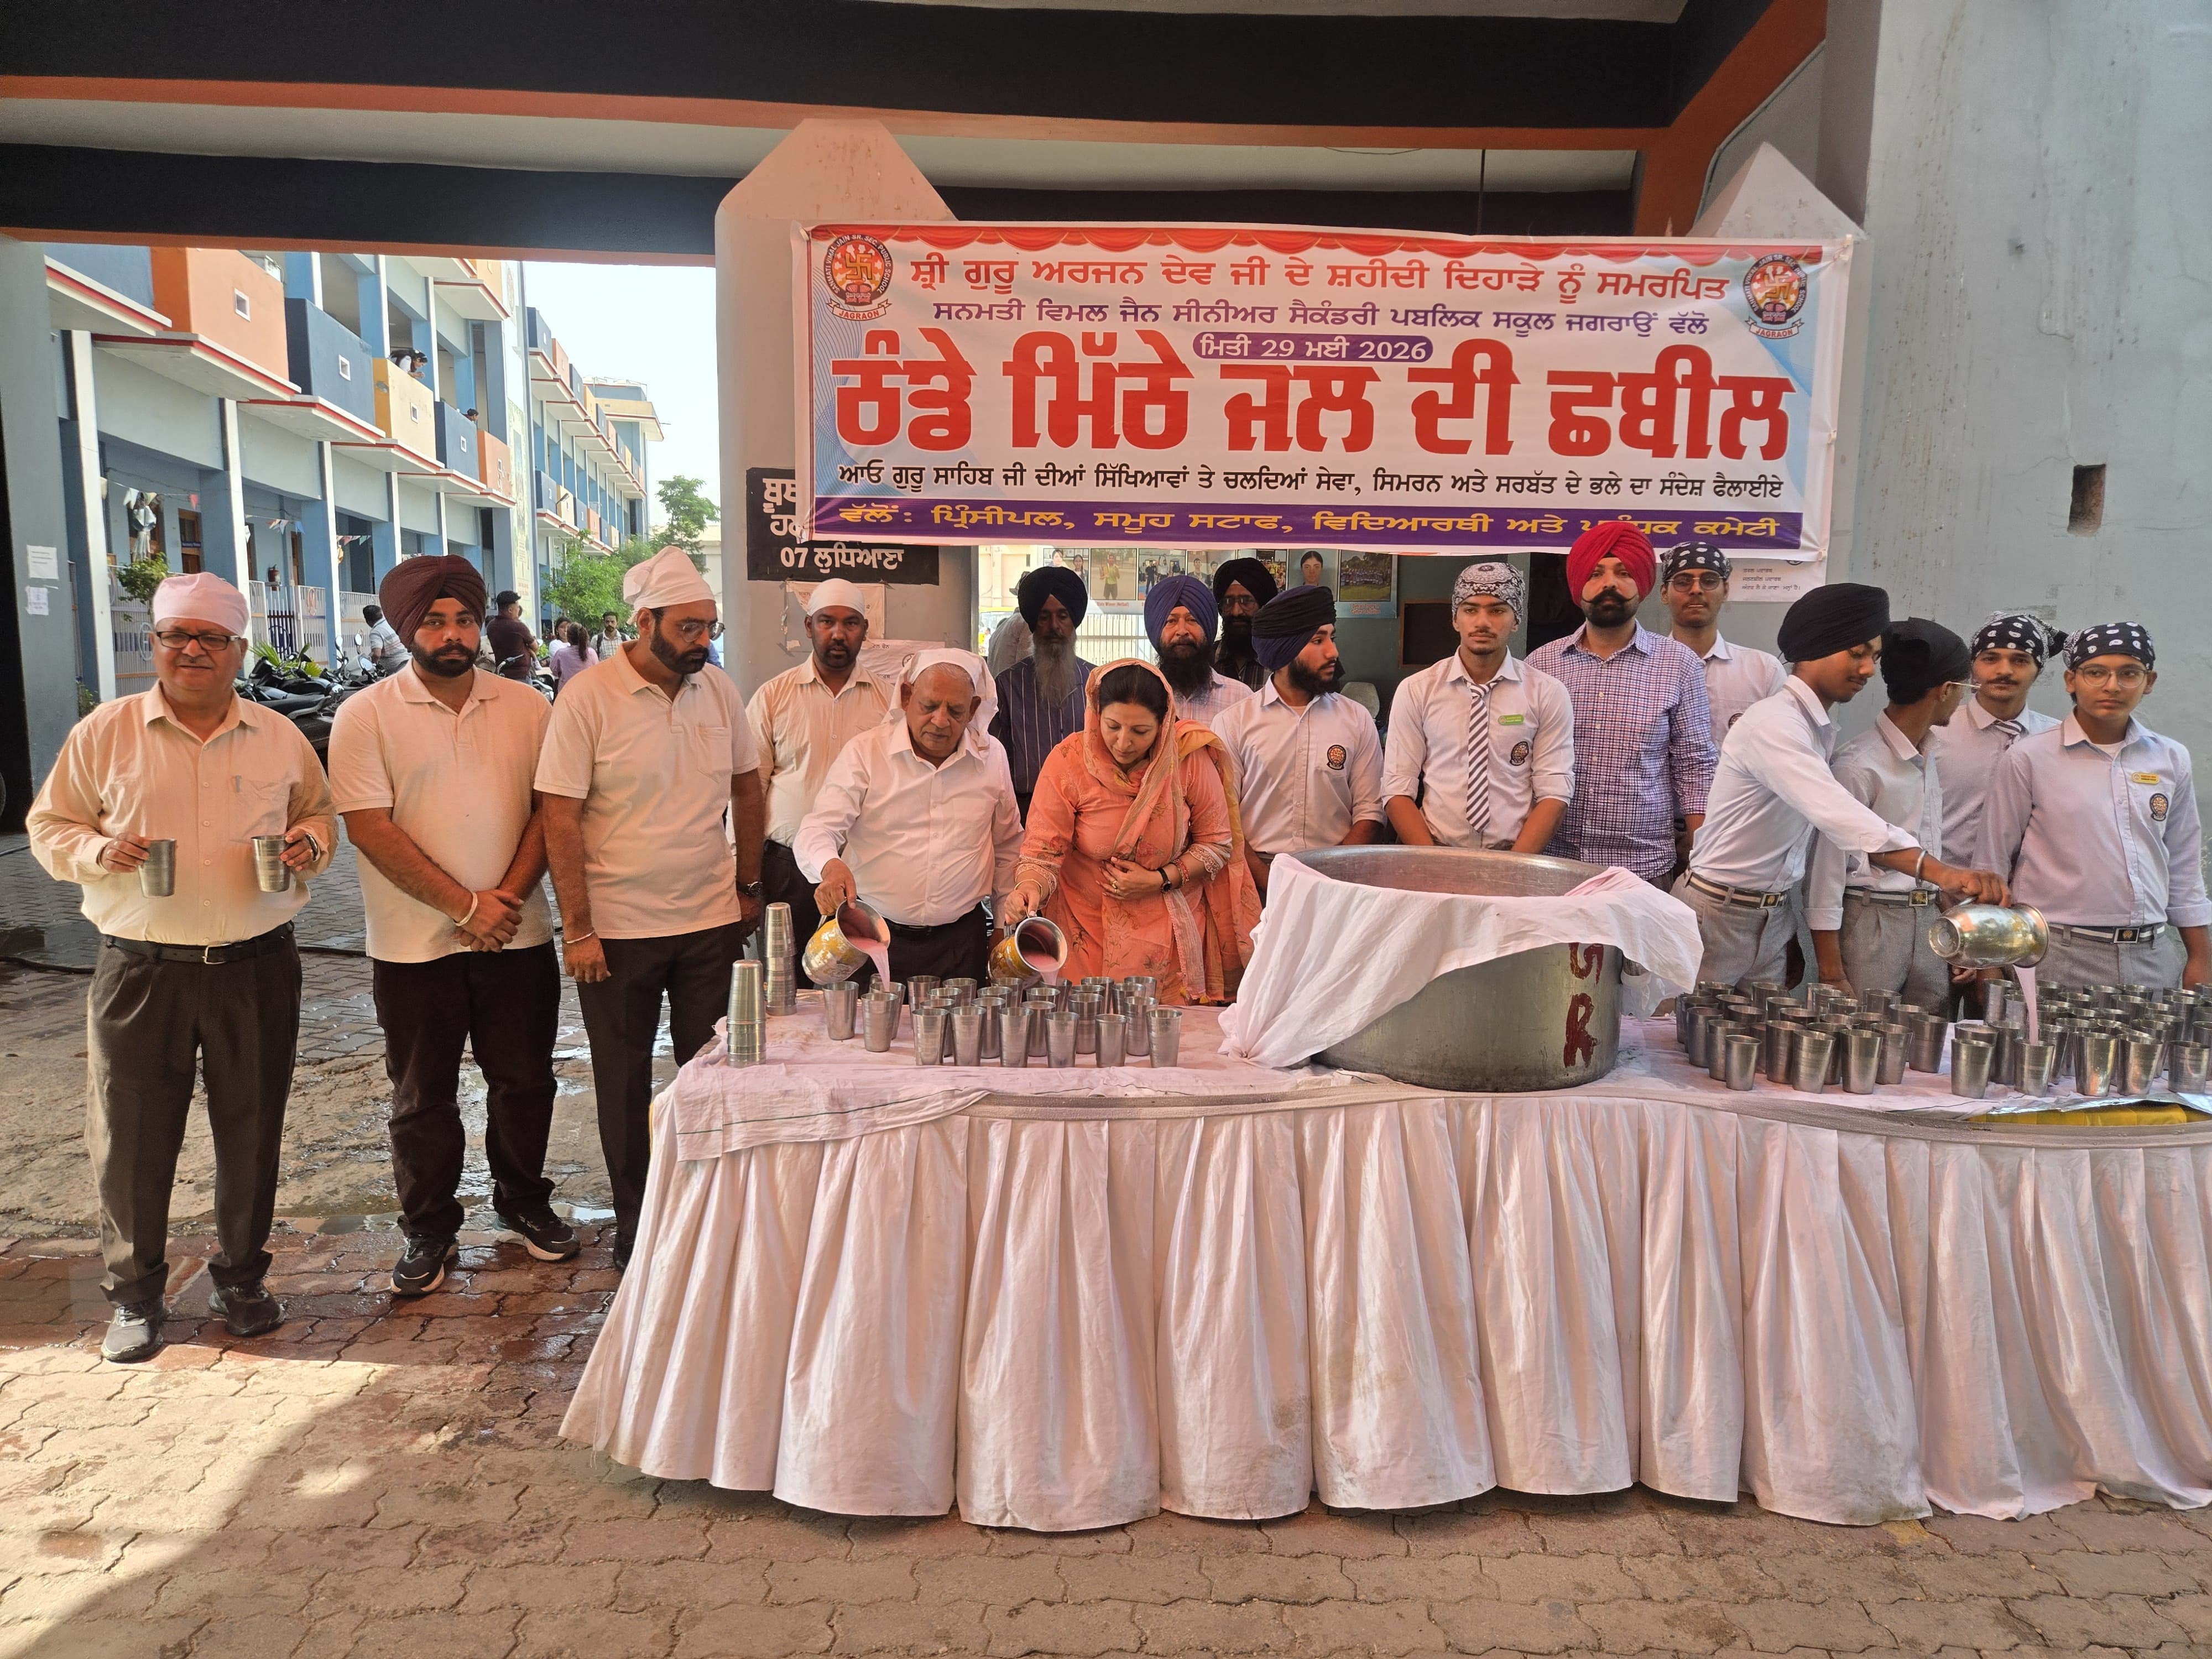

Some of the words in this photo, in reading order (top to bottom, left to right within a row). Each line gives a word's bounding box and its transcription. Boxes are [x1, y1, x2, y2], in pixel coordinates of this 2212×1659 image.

[837, 235, 850, 247] JAIN
[864, 236, 877, 247] SEC.
[827, 247, 837, 264] VIMAL
[878, 244, 891, 267] PUBLIC
[826, 265, 839, 293] SANMATI
[877, 269, 891, 294] SCHOOL
[963, 260, 1020, 295] ਗੁਰੂ
[1031, 260, 1148, 284] ਅਰਜਨ
[1161, 254, 1216, 285] ਦੇਵ
[1230, 254, 1271, 286] ਜੀ
[1285, 257, 1314, 286] ਦੇ
[1598, 268, 1728, 299] ਸਮਰਪਿਤ
[1791, 290, 1806, 312] SCHOOL
[839, 310, 879, 319] JAGRAON
[933, 298, 1025, 320] ਸਨਮਤੀ
[1036, 298, 1109, 321] ਵਿਮਲ
[1119, 296, 1162, 322] ਜੈਨ
[1390, 304, 1483, 327] ਪਬਲਿਕ
[1493, 312, 1556, 337] ਸਕੂਲ
[1756, 329, 1793, 337] JAGRAON
[1200, 333, 1251, 356] ਮਿਤੀ
[1261, 340, 1294, 356] 29
[1306, 336, 1349, 358] ਮਈ
[1359, 342, 1426, 359] 2026
[832, 327, 977, 451] ਠੰਡੇ
[1001, 329, 1194, 450] ਮਿੱਠੇ
[1219, 363, 1380, 453] ਜਲ
[1407, 338, 1520, 455] ਦੀ
[1547, 345, 1795, 460] ਛਬੀਲ
[839, 460, 884, 483] ਆਓ
[893, 467, 925, 492] ਗੁਰੂ
[933, 461, 994, 485] ਸਾਹਿਬ
[1003, 462, 1026, 486] ਜੀ
[1035, 462, 1086, 487] ਦੀਆਂ
[1198, 465, 1215, 488] ਤੇ
[1224, 466, 1308, 489] ਚਲਦਿਆਂ
[1373, 467, 1443, 492] ਸਿਮਰਨ
[1452, 469, 1488, 492] ਅਤੇ
[1496, 471, 1557, 493] ਸਰਬੱਤ
[1590, 471, 1622, 494] ਭਲੇ
[1630, 479, 1652, 495] ਦਾ
[1095, 513, 1173, 534] ਸਮੂਹ
[1508, 514, 1566, 533] ਅਤੇ
[1694, 517, 1778, 536] ਕਮੇਟੀ
[781, 547, 808, 567] 07
[814, 542, 904, 573] ਲੁਧਿਆਣਾ
